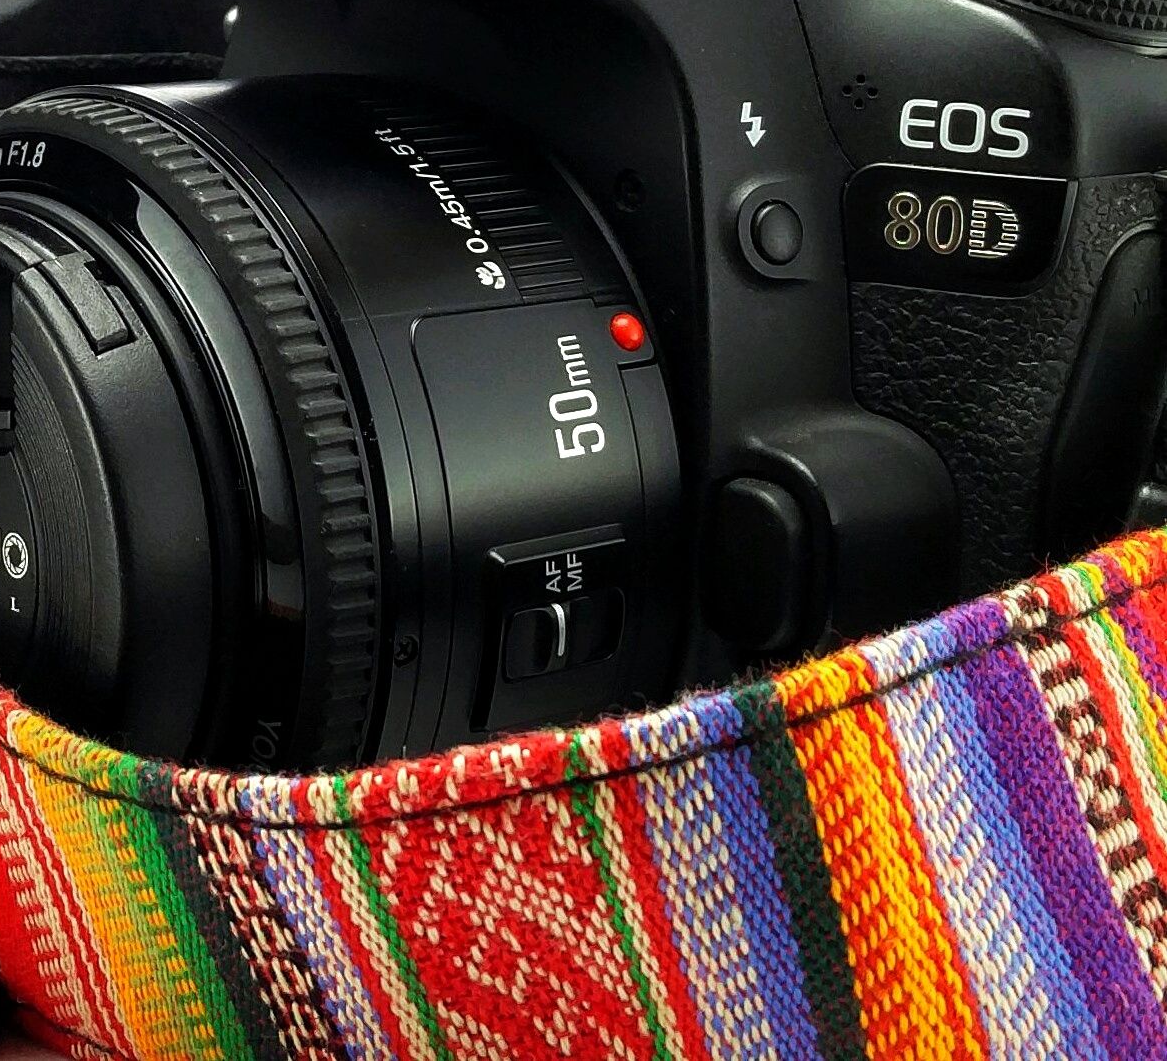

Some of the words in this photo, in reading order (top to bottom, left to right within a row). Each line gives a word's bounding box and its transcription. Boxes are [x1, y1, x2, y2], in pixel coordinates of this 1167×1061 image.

[899, 98, 1031, 158] EOS
[7, 140, 46, 169] F1.8
[883, 191, 1019, 259] 80D
[548, 334, 606, 459] 50mm
[545, 559, 561, 593] AF
[566, 553, 583, 592] MF
